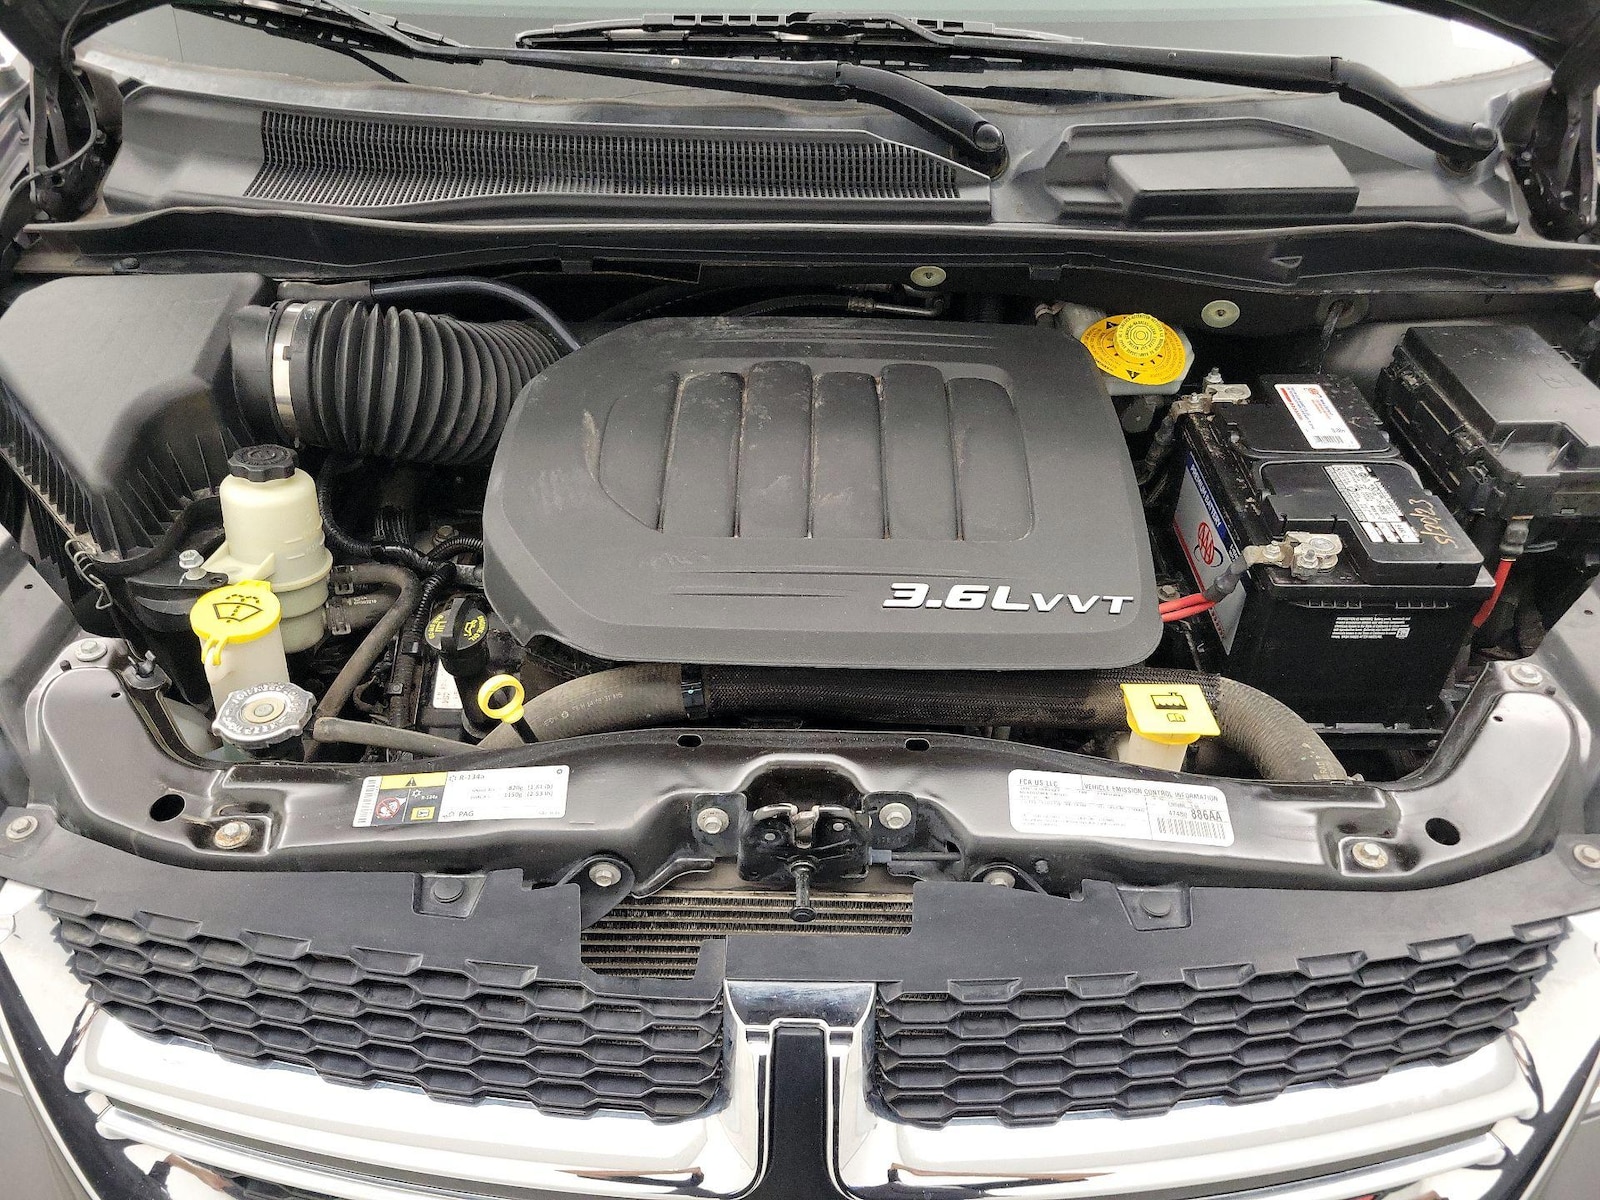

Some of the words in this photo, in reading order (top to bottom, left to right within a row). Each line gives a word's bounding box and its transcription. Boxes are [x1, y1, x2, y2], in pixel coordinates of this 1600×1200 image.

[1204, 494, 1221, 527] BATTERY
[882, 582, 1030, 611] 3.6L
[1031, 592, 1134, 614] VVT
[1084, 783, 1110, 792] VEHICLE
[1111, 785, 1143, 795] EMISSION
[1144, 788, 1173, 798] CONTROL
[1174, 792, 1219, 802] INFORMATION
[1191, 808, 1223, 822] 886AA
